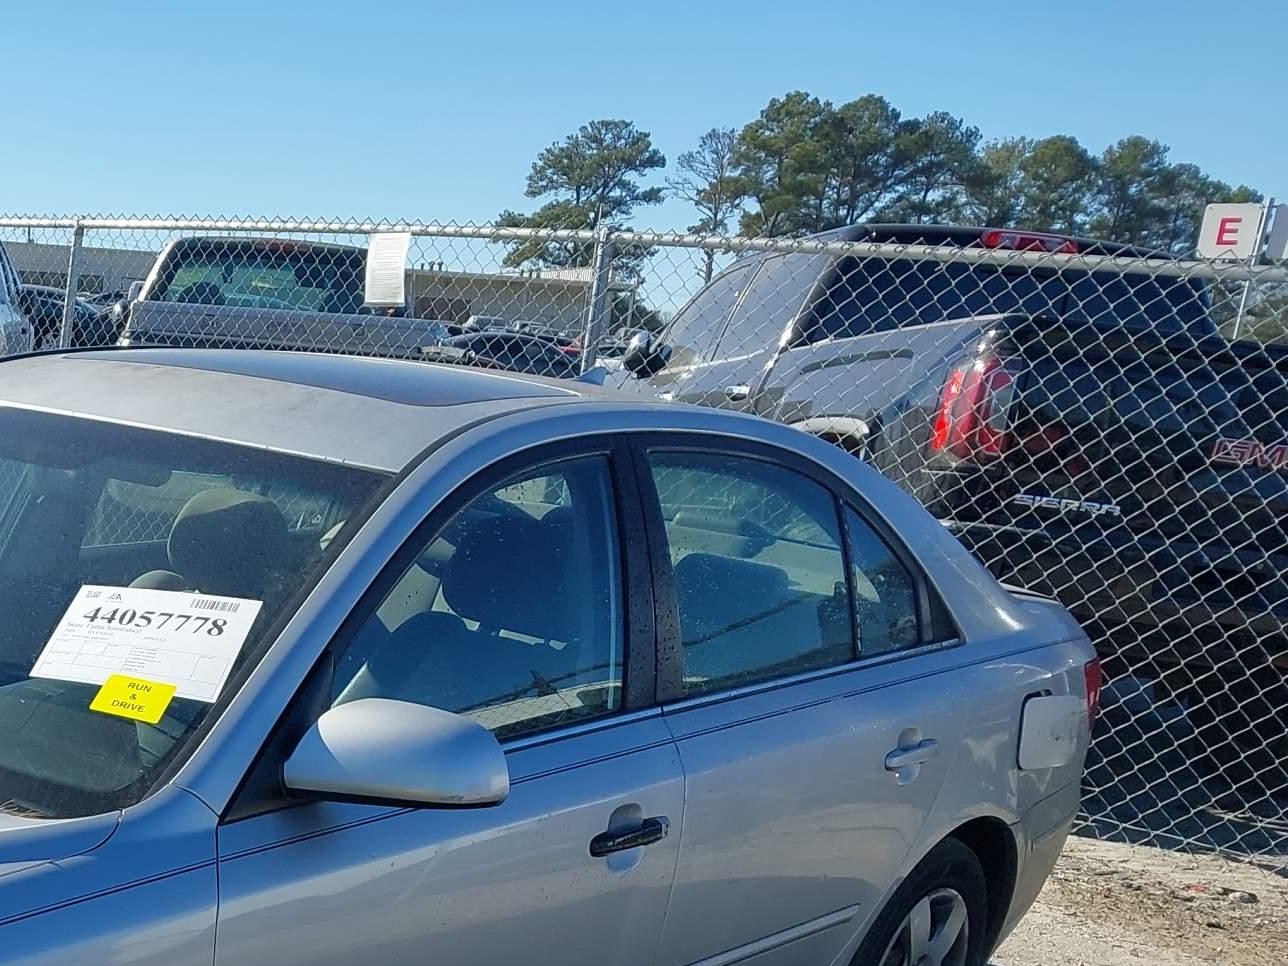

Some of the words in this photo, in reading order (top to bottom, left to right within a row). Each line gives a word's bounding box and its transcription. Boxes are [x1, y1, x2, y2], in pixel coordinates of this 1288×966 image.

[1215, 217, 1243, 246] E
[1212, 437, 1288, 470] GM
[1013, 493, 1121, 516] SIERRA
[82, 606, 228, 637] 44057778
[127, 682, 152, 692] RUN
[111, 699, 145, 713] DRIVE
